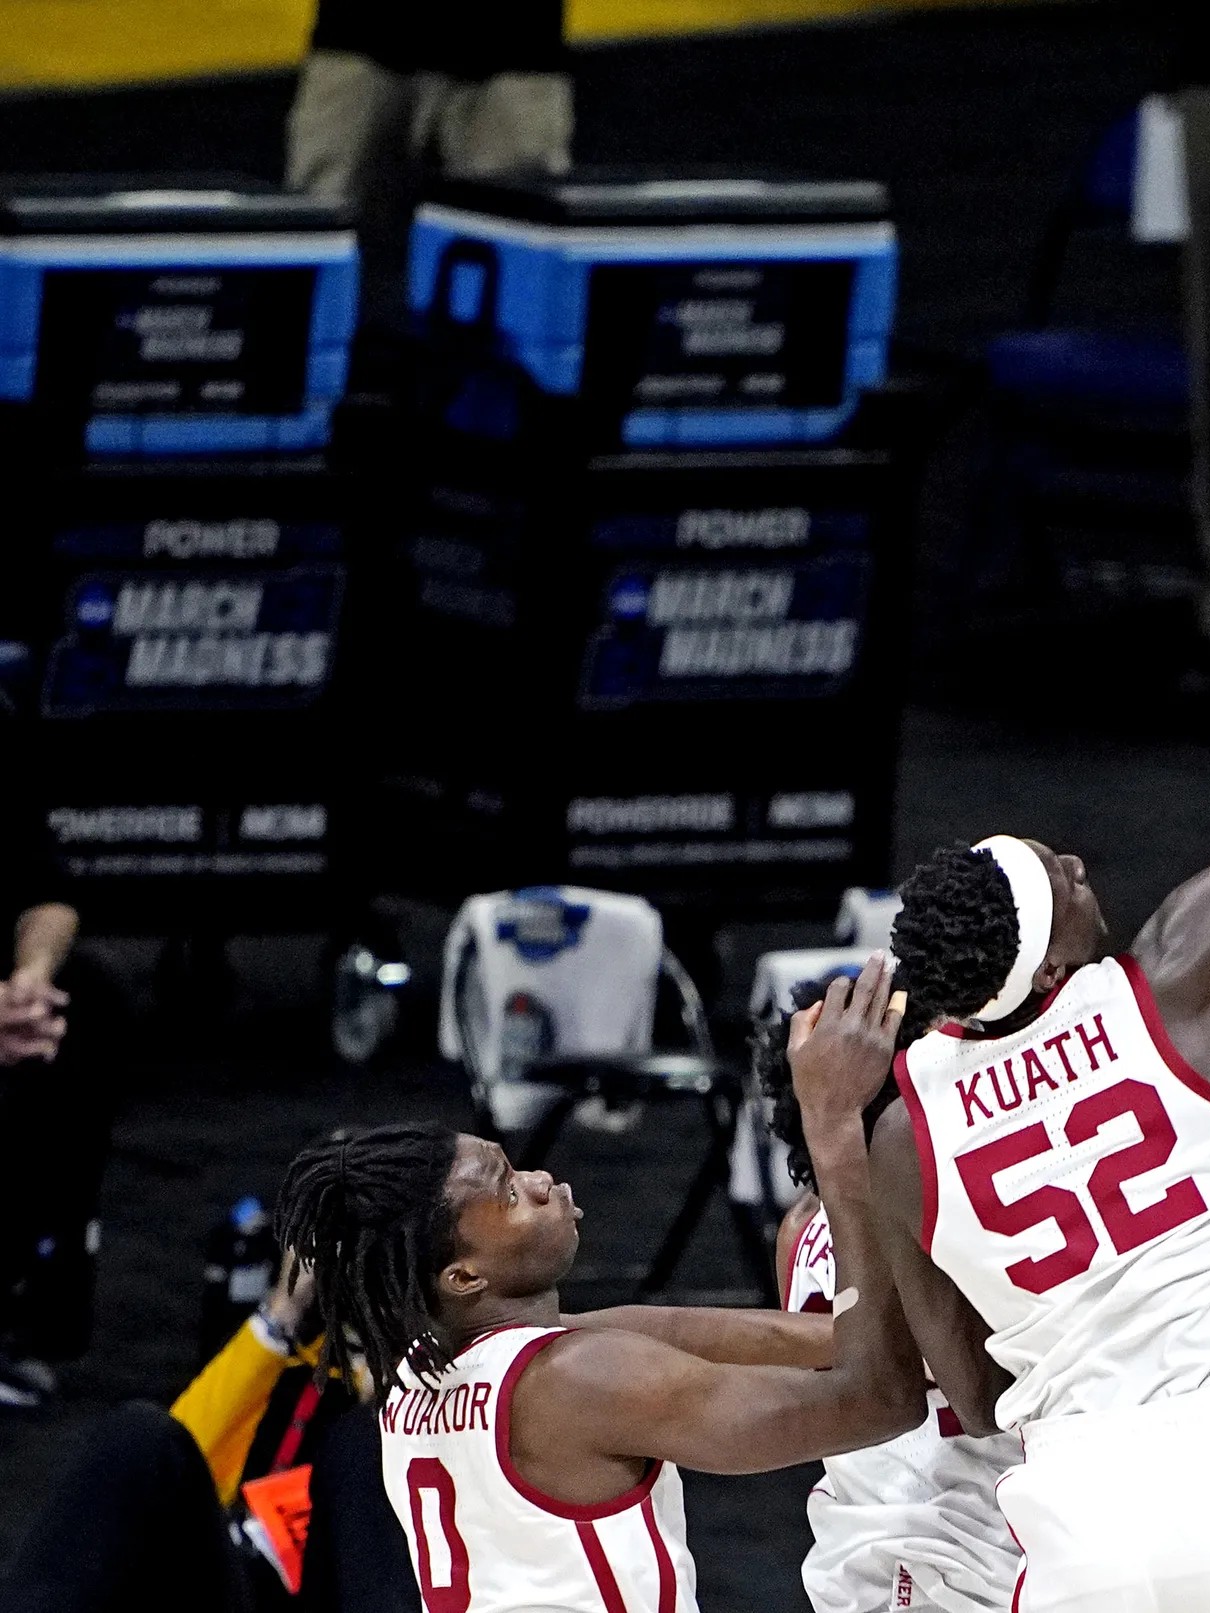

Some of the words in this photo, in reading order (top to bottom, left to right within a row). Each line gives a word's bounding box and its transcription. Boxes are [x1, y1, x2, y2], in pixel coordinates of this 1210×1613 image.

[955, 1013, 1118, 1127] KUATH
[954, 1078, 1208, 1295] 52
[407, 1458, 471, 1613] 0
